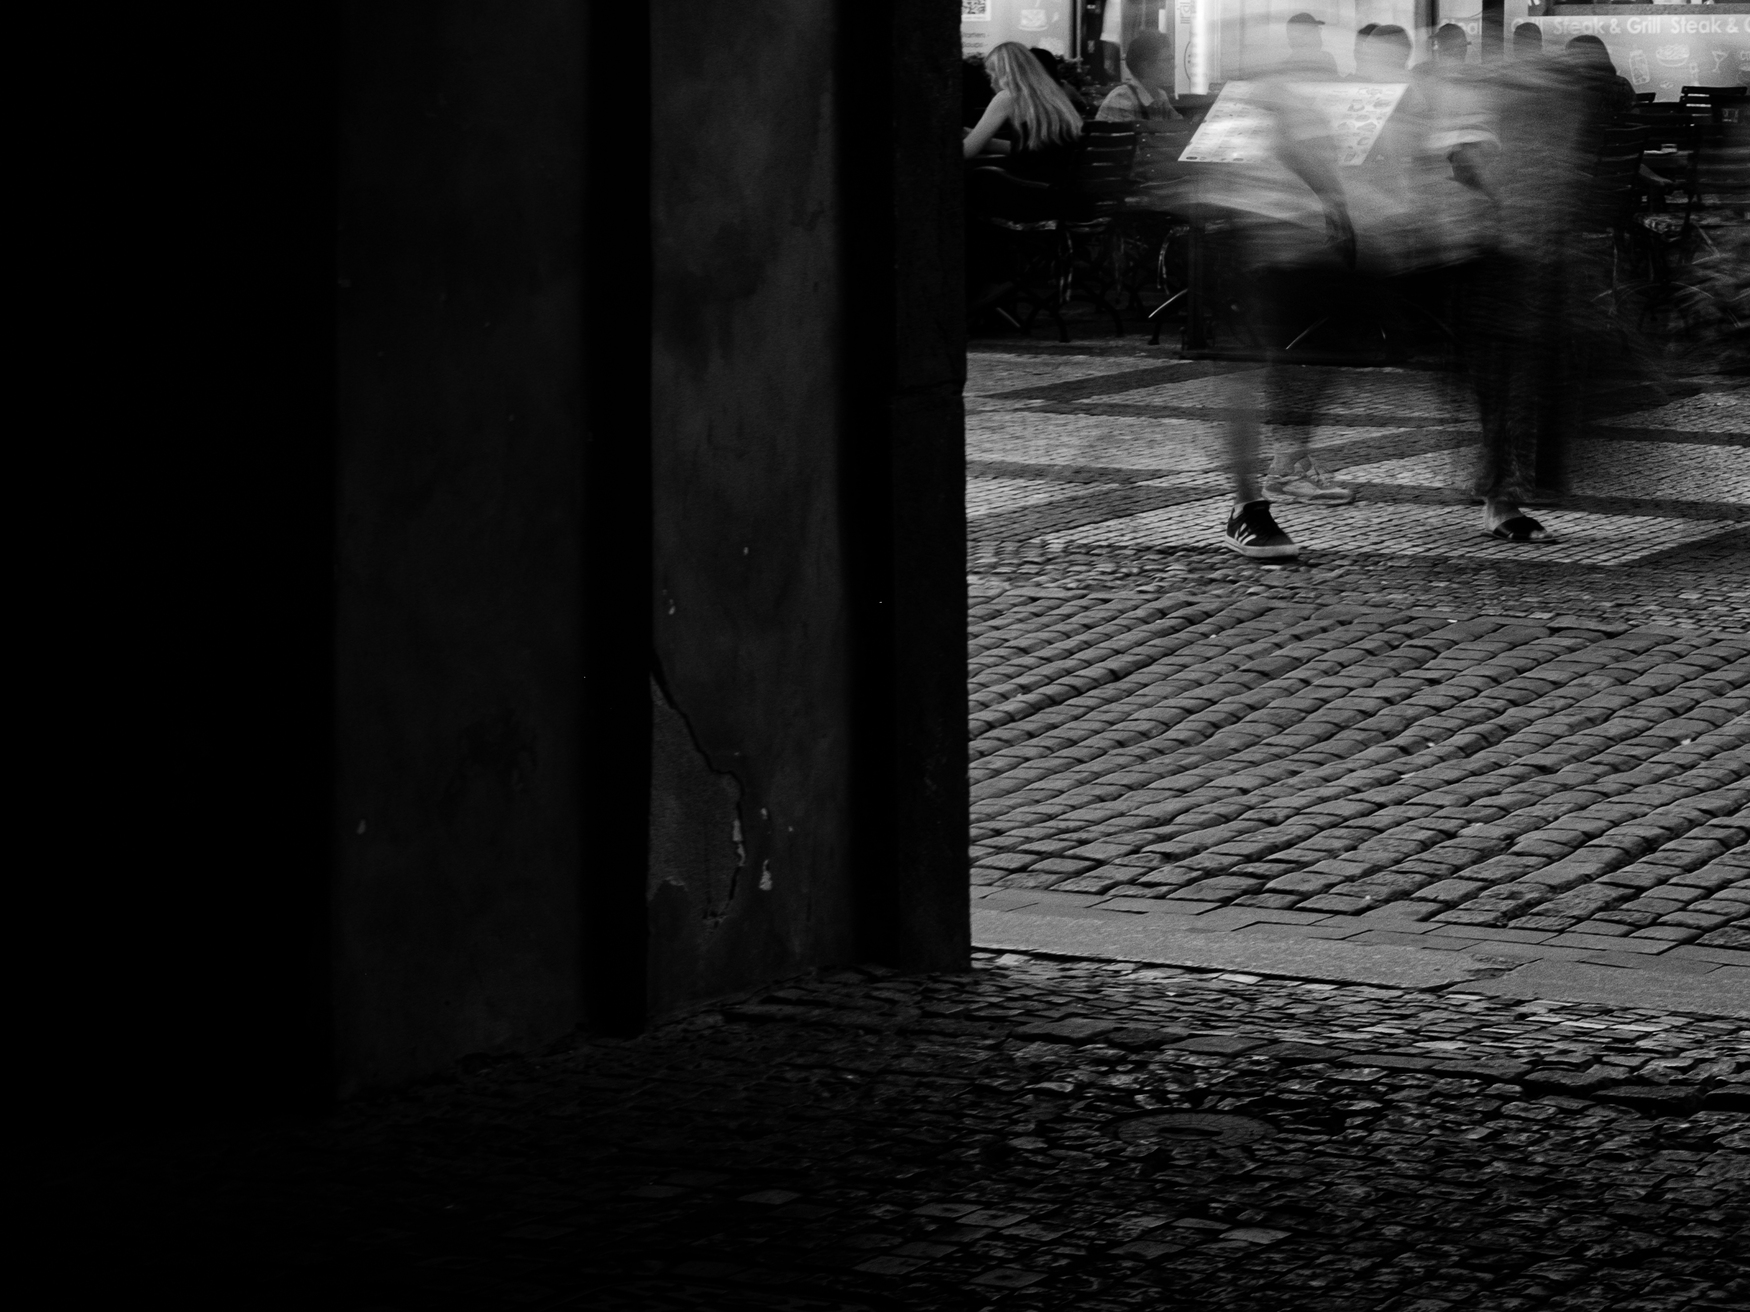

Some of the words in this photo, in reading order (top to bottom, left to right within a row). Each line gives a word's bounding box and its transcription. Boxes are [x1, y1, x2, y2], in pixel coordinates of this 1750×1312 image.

[1553, 16, 1605, 35] Steak
[1609, 17, 1621, 35] &
[1626, 16, 1661, 35] Grill
[1670, 16, 1722, 35] Steak
[1725, 16, 1739, 34] &
